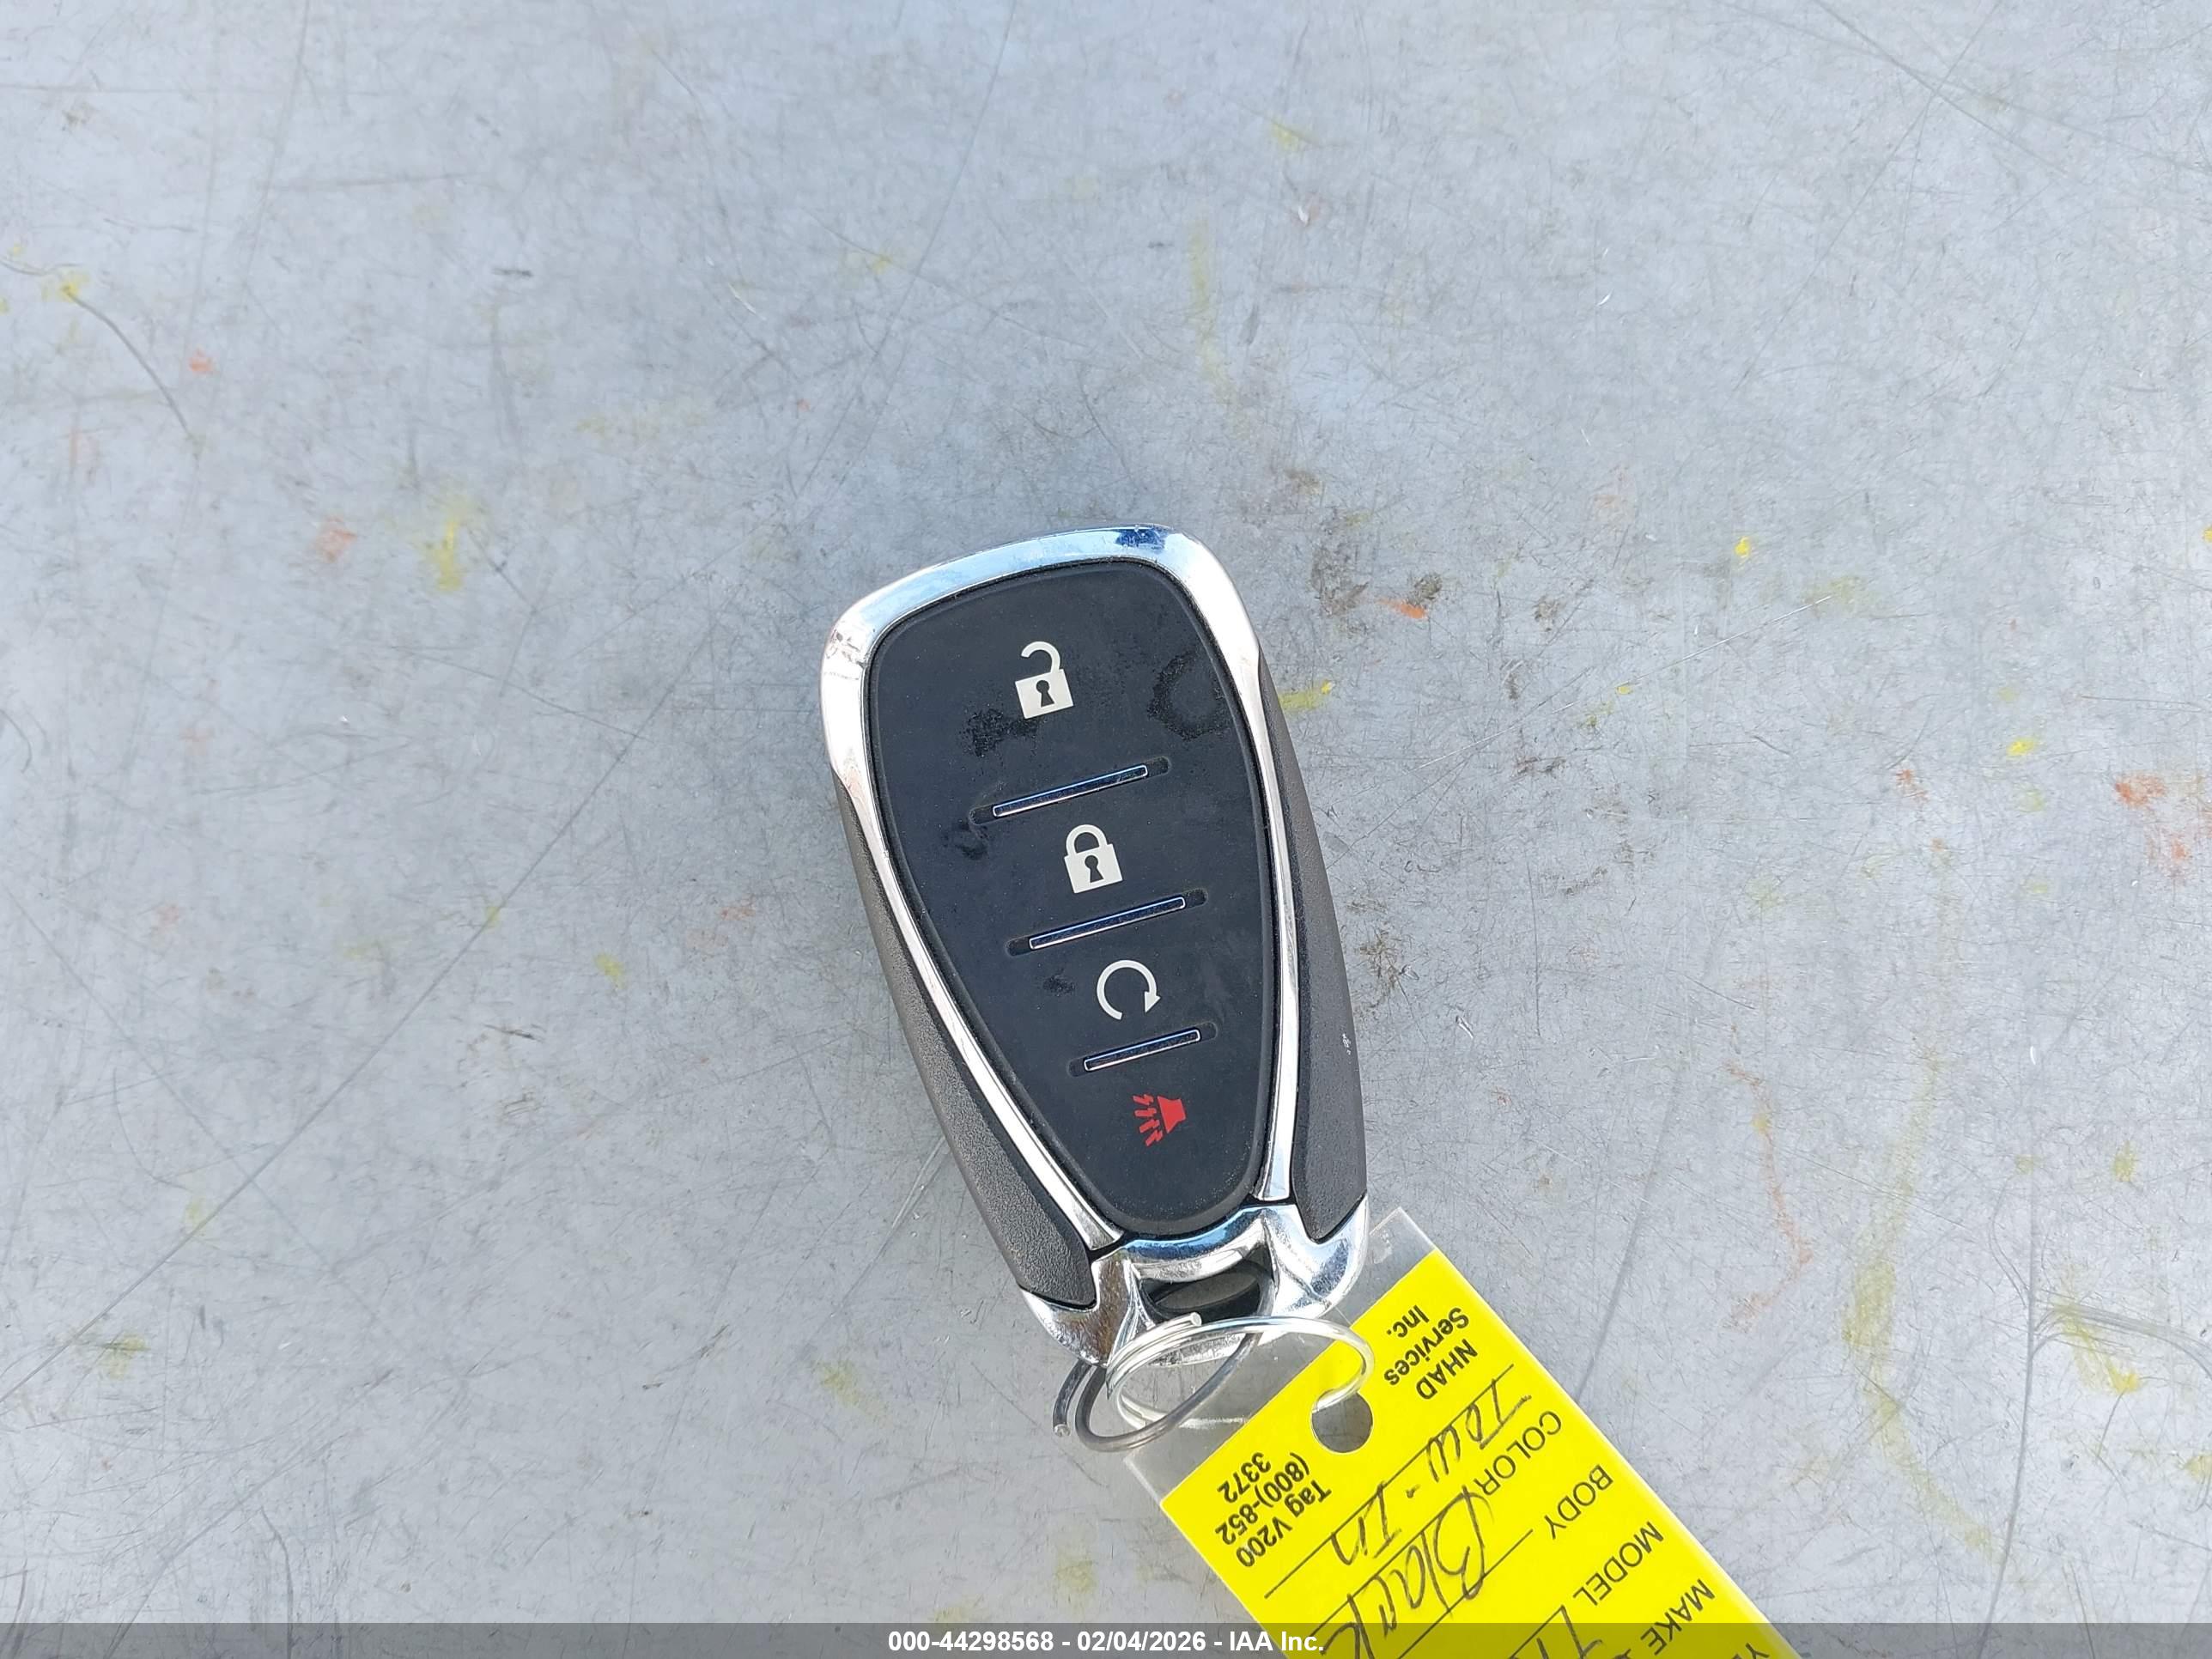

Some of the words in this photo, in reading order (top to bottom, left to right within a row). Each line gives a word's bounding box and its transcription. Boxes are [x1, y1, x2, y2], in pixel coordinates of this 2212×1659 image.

[1383, 1307, 1469, 1386] Services
[1387, 1304, 1430, 1338] Inc.
[1416, 1339, 1478, 1400] NHAD
[1217, 1452, 1271, 1503] 3372
[1474, 1411, 1562, 1495] COLOR
[1215, 1452, 1310, 1545] (800)-852
[1285, 1480, 1332, 1517] Tag
[1544, 1465, 1613, 1540] BODY
[1237, 1516, 1292, 1566] V200
[1320, 1486, 1494, 1659] Black
[1572, 1522, 1664, 1606] MODEL
[1641, 1579, 1715, 1656] MAKE
